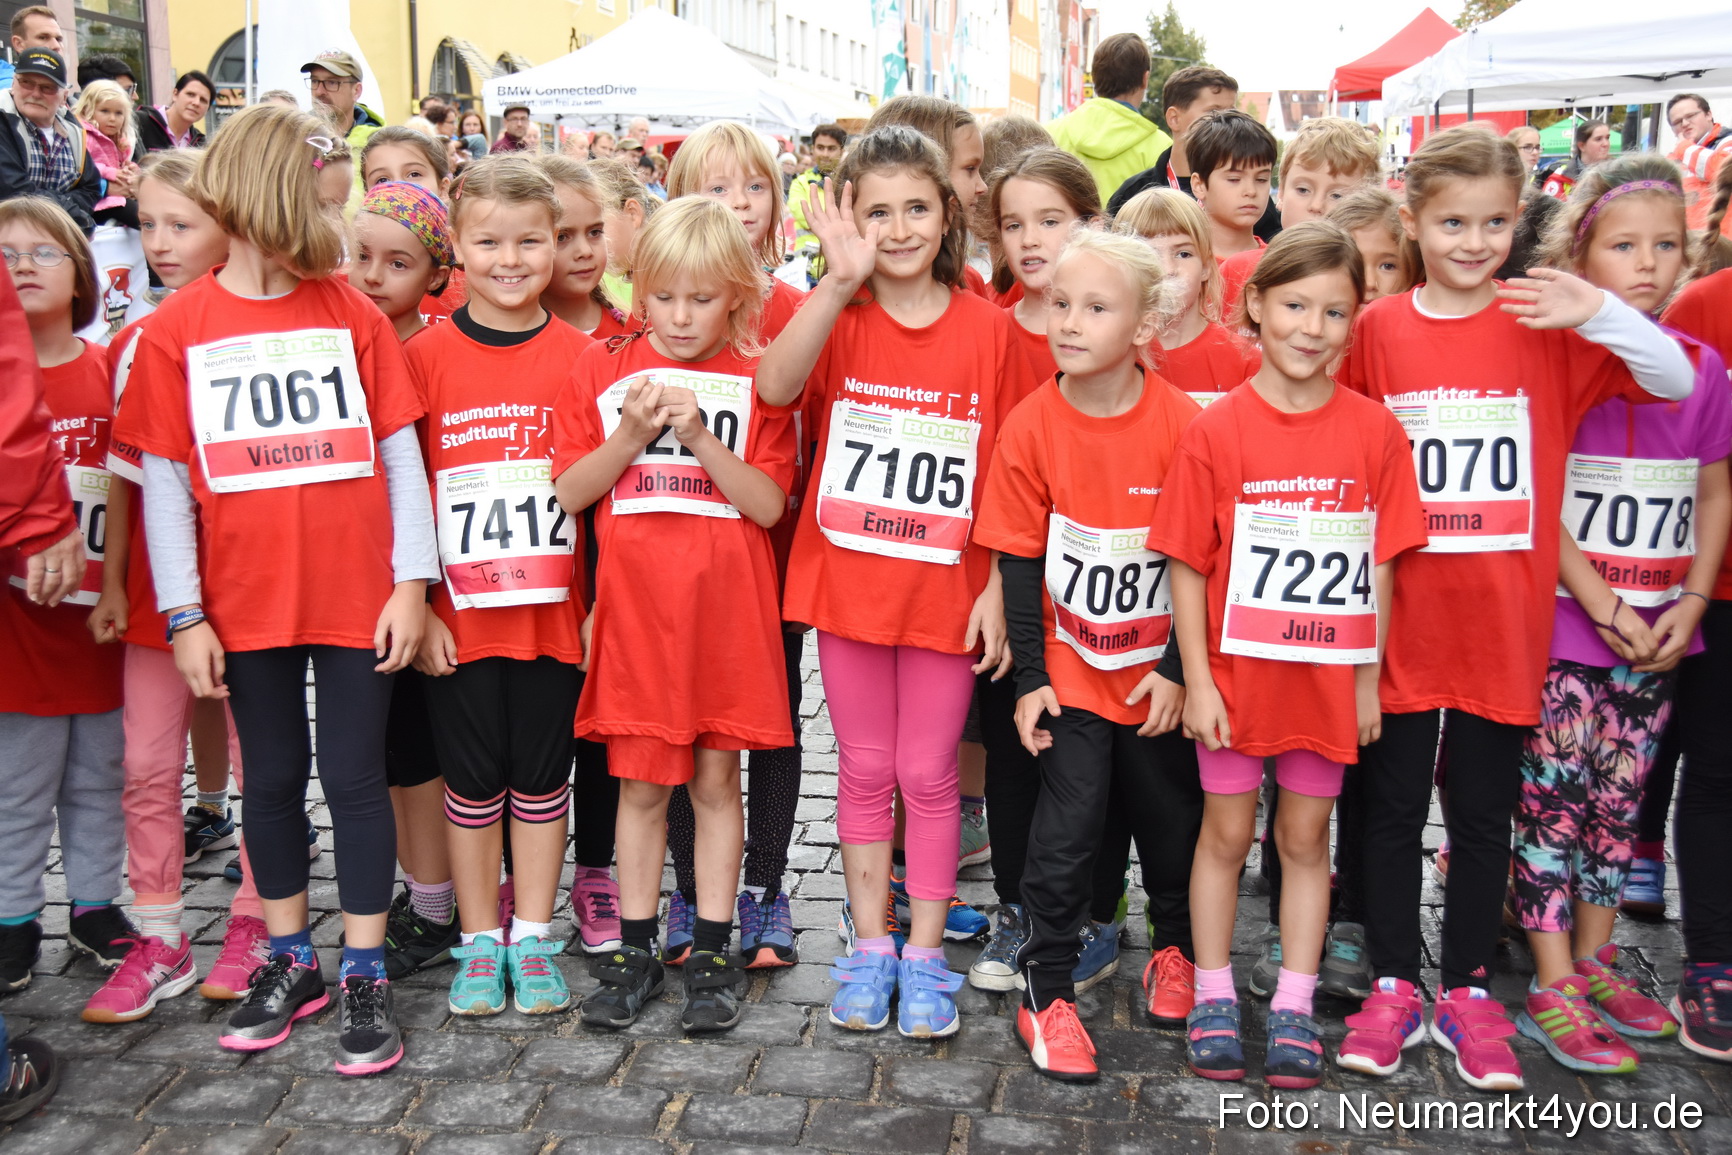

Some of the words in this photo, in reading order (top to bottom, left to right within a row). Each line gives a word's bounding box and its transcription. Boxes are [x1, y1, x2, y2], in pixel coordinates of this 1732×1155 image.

[497, 86, 531, 96] BMW
[265, 335, 343, 357] BOCK
[204, 354, 257, 369] NeuerMarkt
[210, 366, 349, 432] 7061
[844, 377, 942, 403] Neumarkter
[358, 416, 364, 425] K
[442, 403, 537, 428] Neumarkter
[1439, 403, 1518, 423] BOCK
[206, 432, 212, 442] 3
[442, 423, 518, 449] Stadtlauf
[843, 419, 892, 435] NeuerMarkt
[902, 418, 970, 444] BOCK
[247, 440, 335, 466] Victoria
[498, 465, 552, 483] BOC
[844, 440, 966, 509] 7105
[1409, 436, 1518, 493] 070
[1633, 464, 1698, 482] BOCK
[636, 471, 712, 495] Johanna
[1242, 476, 1335, 494] eumarkter
[1570, 470, 1622, 482] NeuerMarkt
[446, 480, 489, 493] NeuerMarkt
[827, 486, 832, 495] 3
[1128, 487, 1139, 495] FC
[1521, 487, 1526, 496] K
[964, 507, 970, 516] K
[1574, 490, 1693, 549] 7078
[451, 495, 568, 554] 7412
[863, 511, 926, 540] Emilia
[1248, 523, 1299, 537] NeuerMarkt
[1310, 518, 1370, 536] BOCK
[568, 543, 573, 552] K
[1061, 532, 1101, 553] NeuerMarkt
[471, 561, 526, 584] Tonia
[1250, 545, 1371, 605] 7224
[1590, 559, 1671, 585] Marlene
[1063, 553, 1167, 616] 7087
[1163, 603, 1169, 612] K
[1234, 593, 1240, 602] 3
[1079, 622, 1139, 650] Hannah
[1282, 619, 1336, 643] Julia
